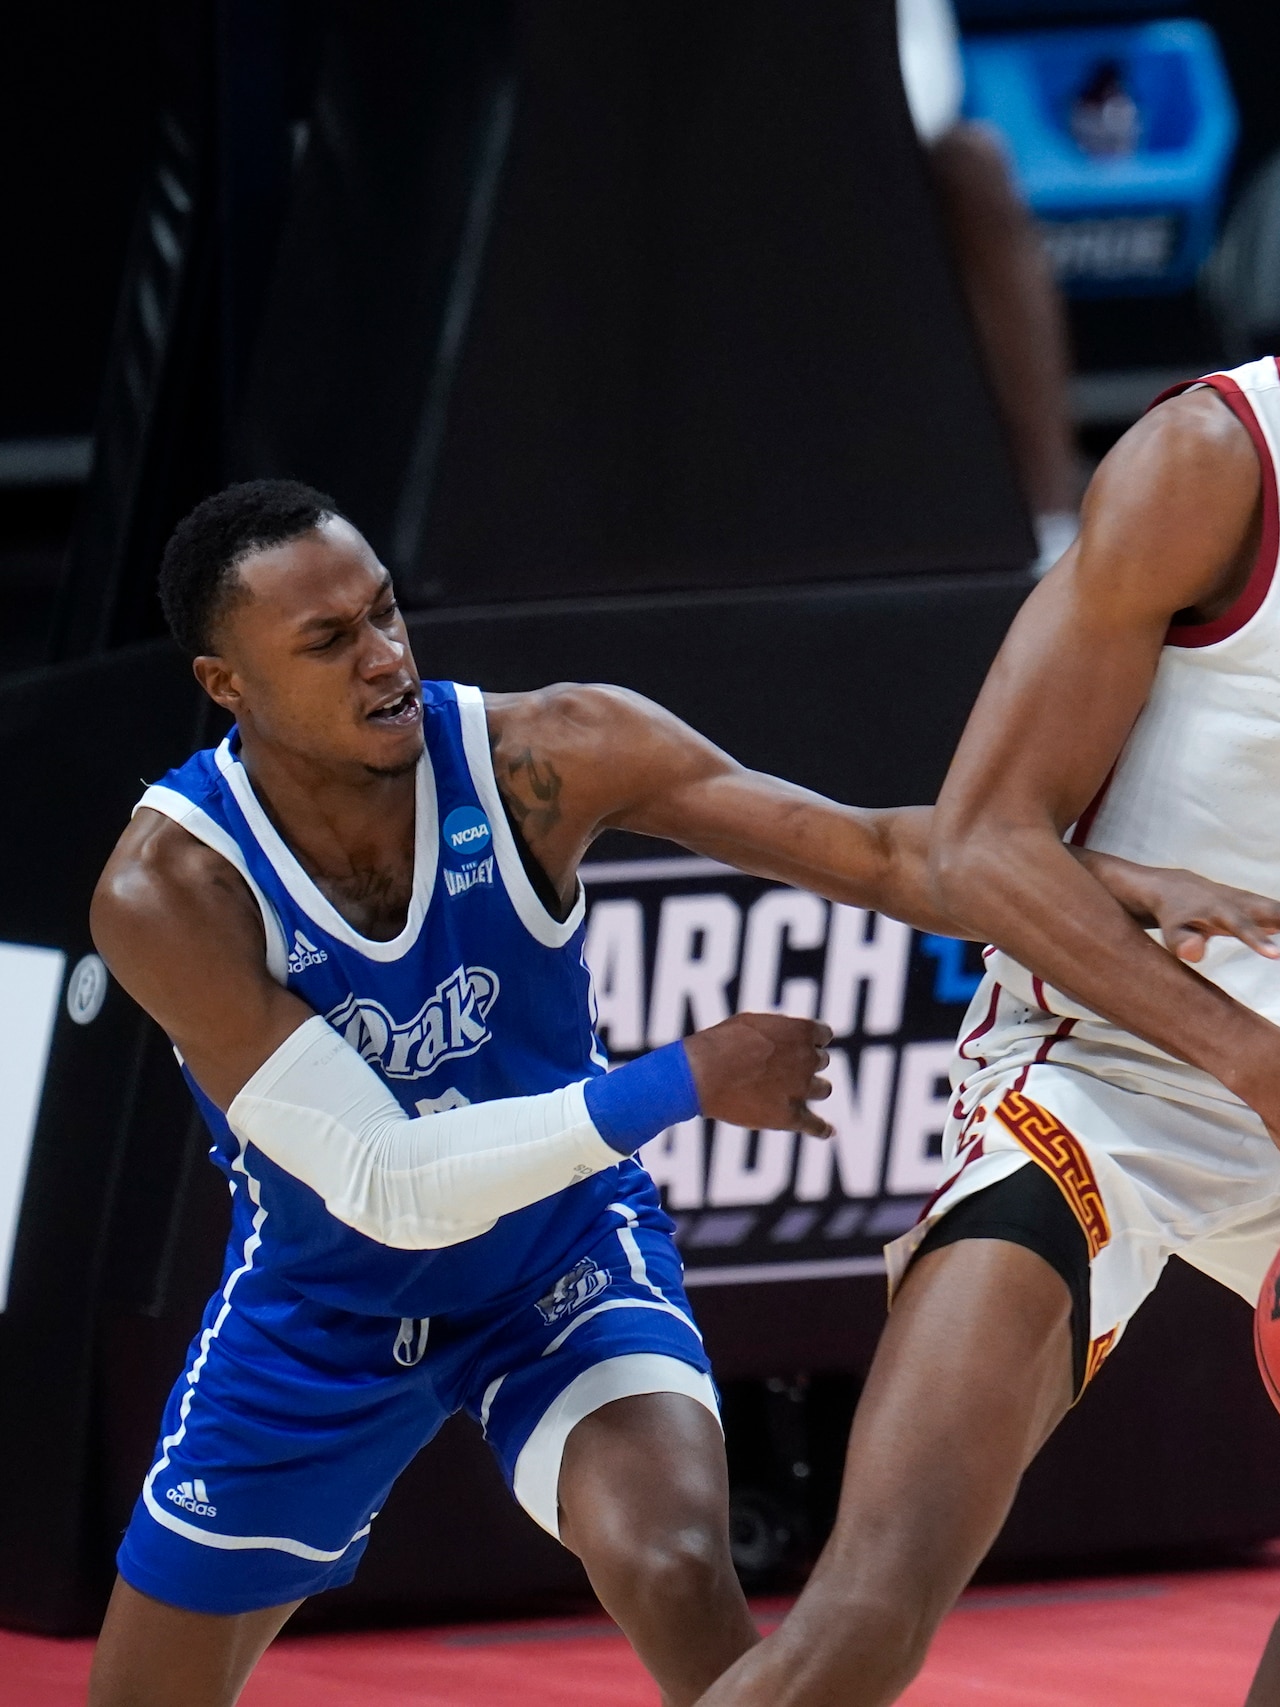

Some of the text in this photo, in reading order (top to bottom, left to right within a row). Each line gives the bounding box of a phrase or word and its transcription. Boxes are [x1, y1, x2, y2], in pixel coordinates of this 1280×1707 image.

[451, 824, 489, 847] NCAA
[443, 855, 494, 897] VALLEY
[584, 888, 913, 1051] ARCH
[642, 1041, 955, 1208] ADNE
[166, 1488, 217, 1518] adidas
